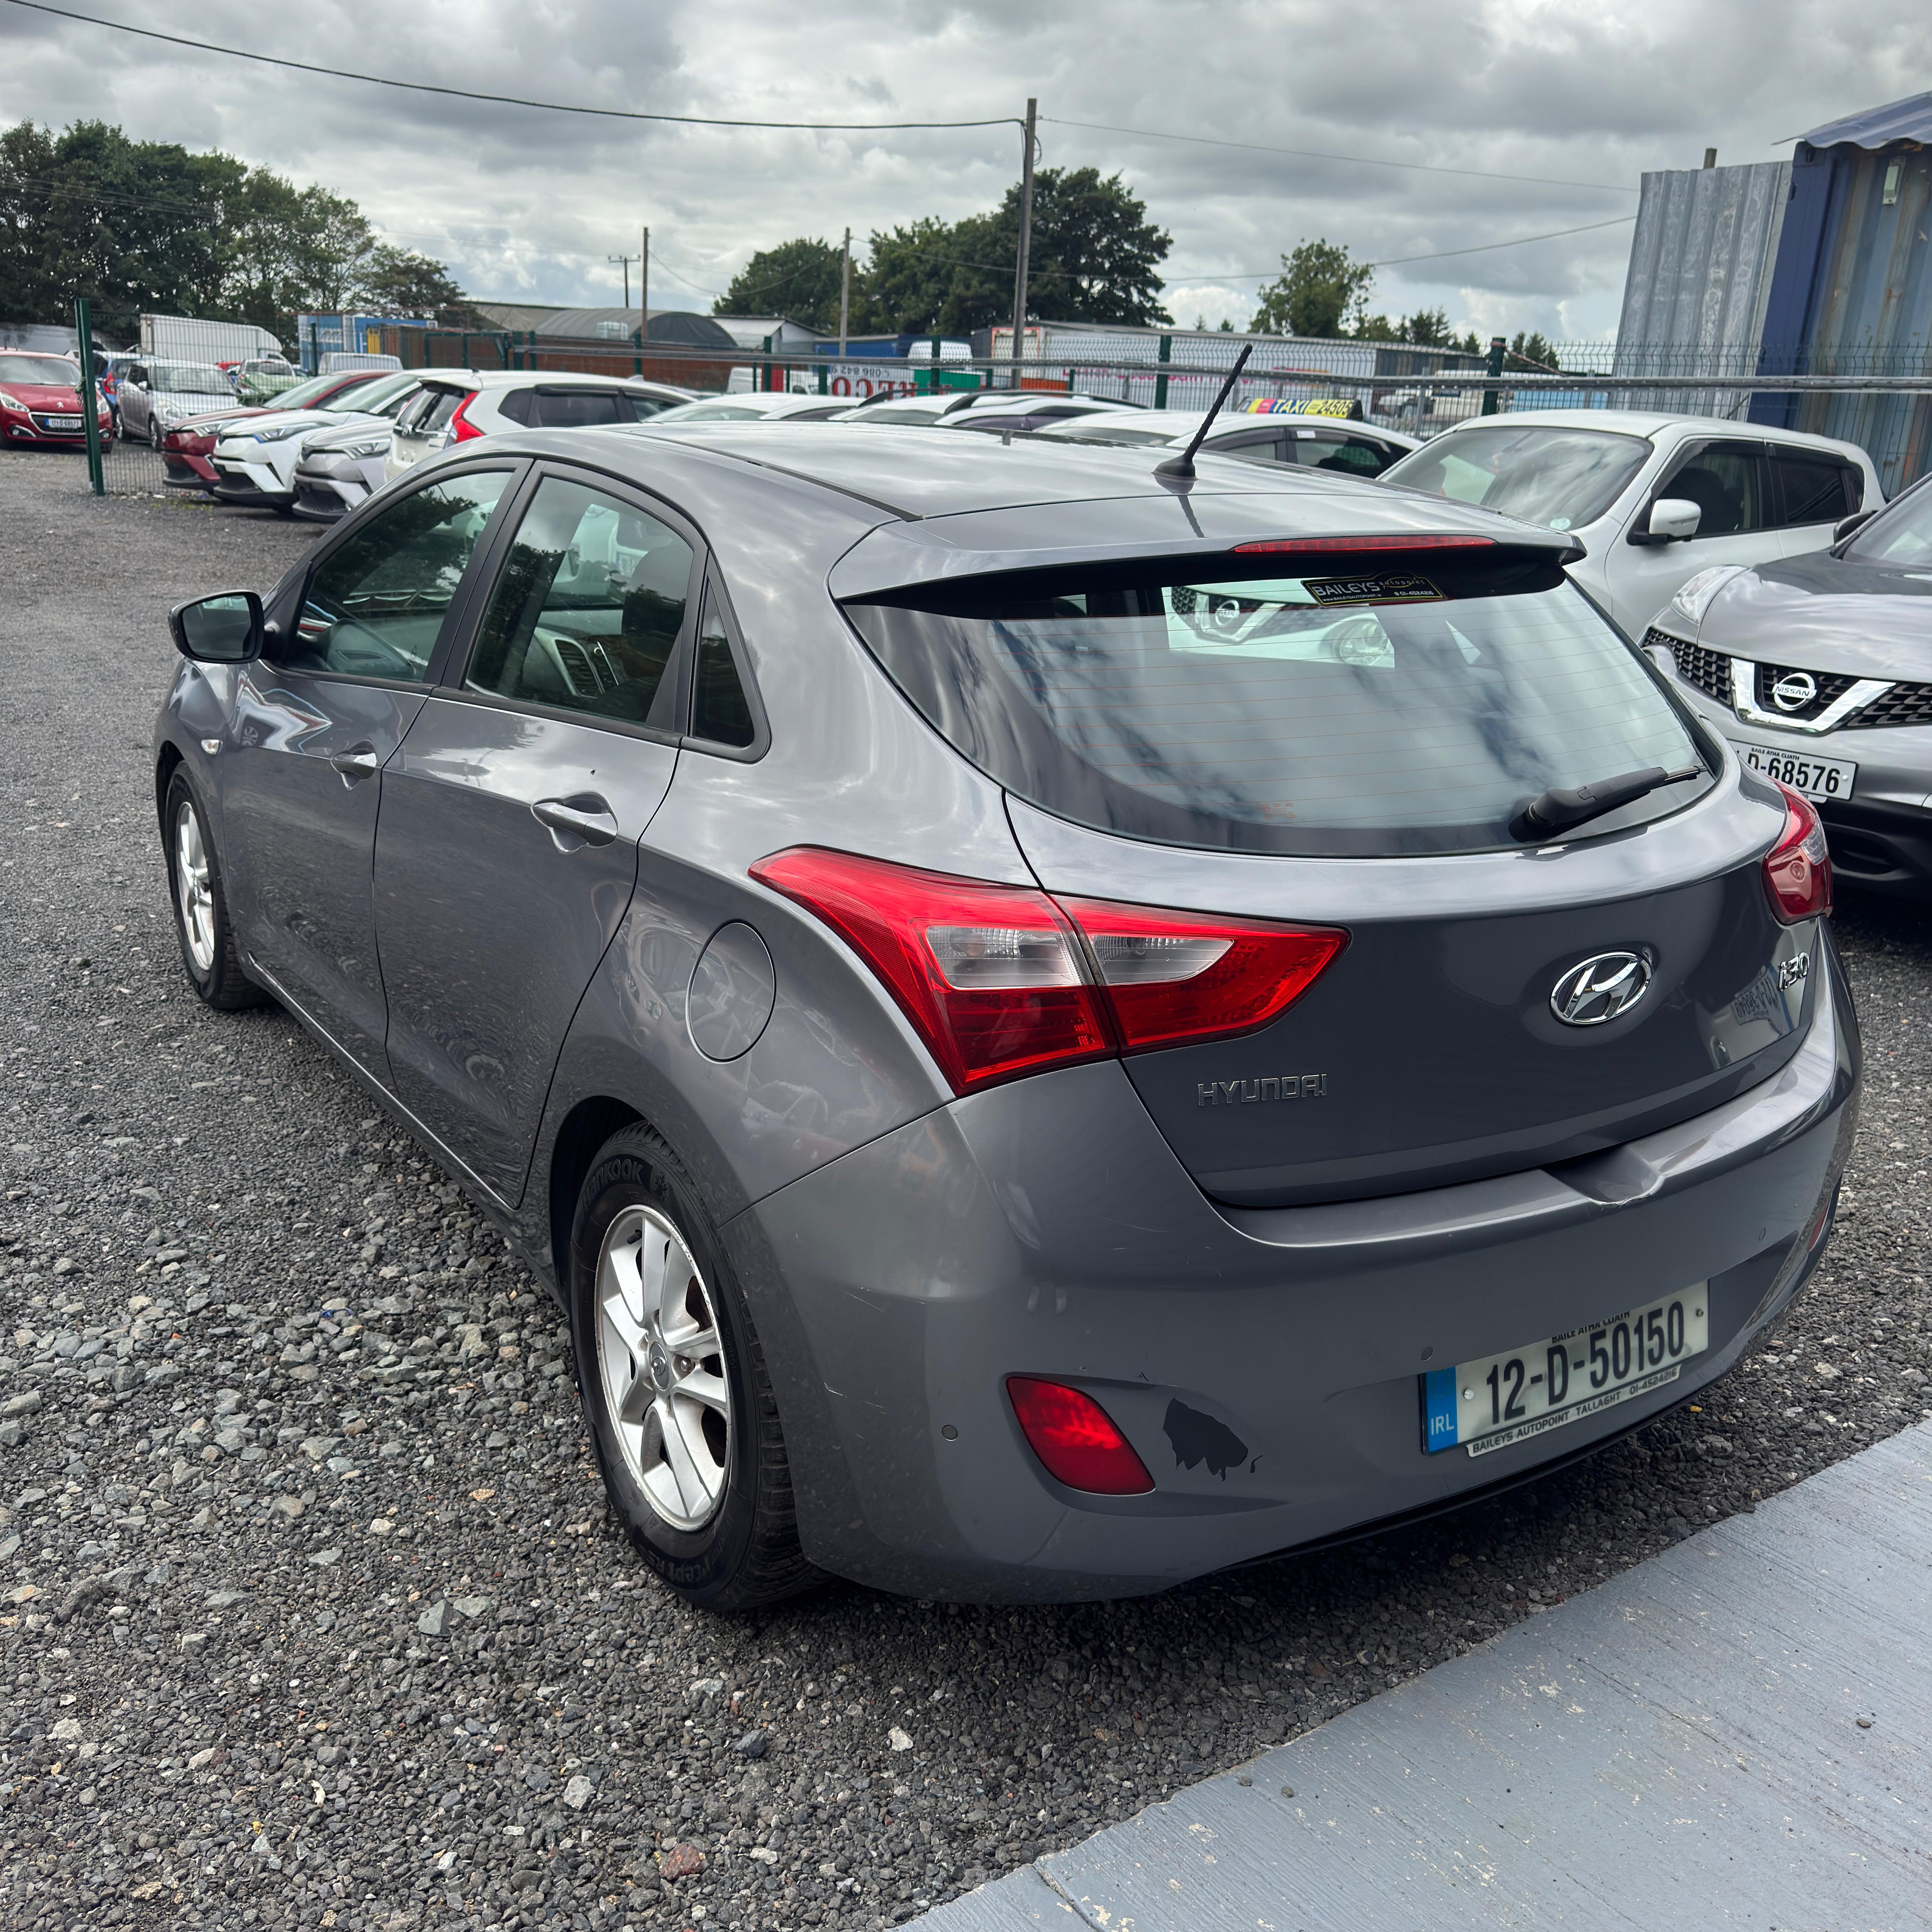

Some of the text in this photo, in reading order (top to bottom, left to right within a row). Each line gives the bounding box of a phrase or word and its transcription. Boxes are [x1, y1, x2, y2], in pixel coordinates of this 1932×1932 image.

[1273, 399, 1309, 414] TAXI
[1312, 581, 1380, 596] BAILEYS
[1775, 686, 1810, 696] NISSAN
[1737, 749, 1840, 793] D-68576
[1198, 1074, 1327, 1106] HYUNDAI
[1486, 1301, 1684, 1424] 12-D-50150
[1431, 1413, 1454, 1435] IRL
[1473, 1431, 1513, 1454] BAILEYS
[1516, 1411, 1570, 1438] AUTOPOINT
[1576, 1391, 1621, 1416] TALLAGHT
